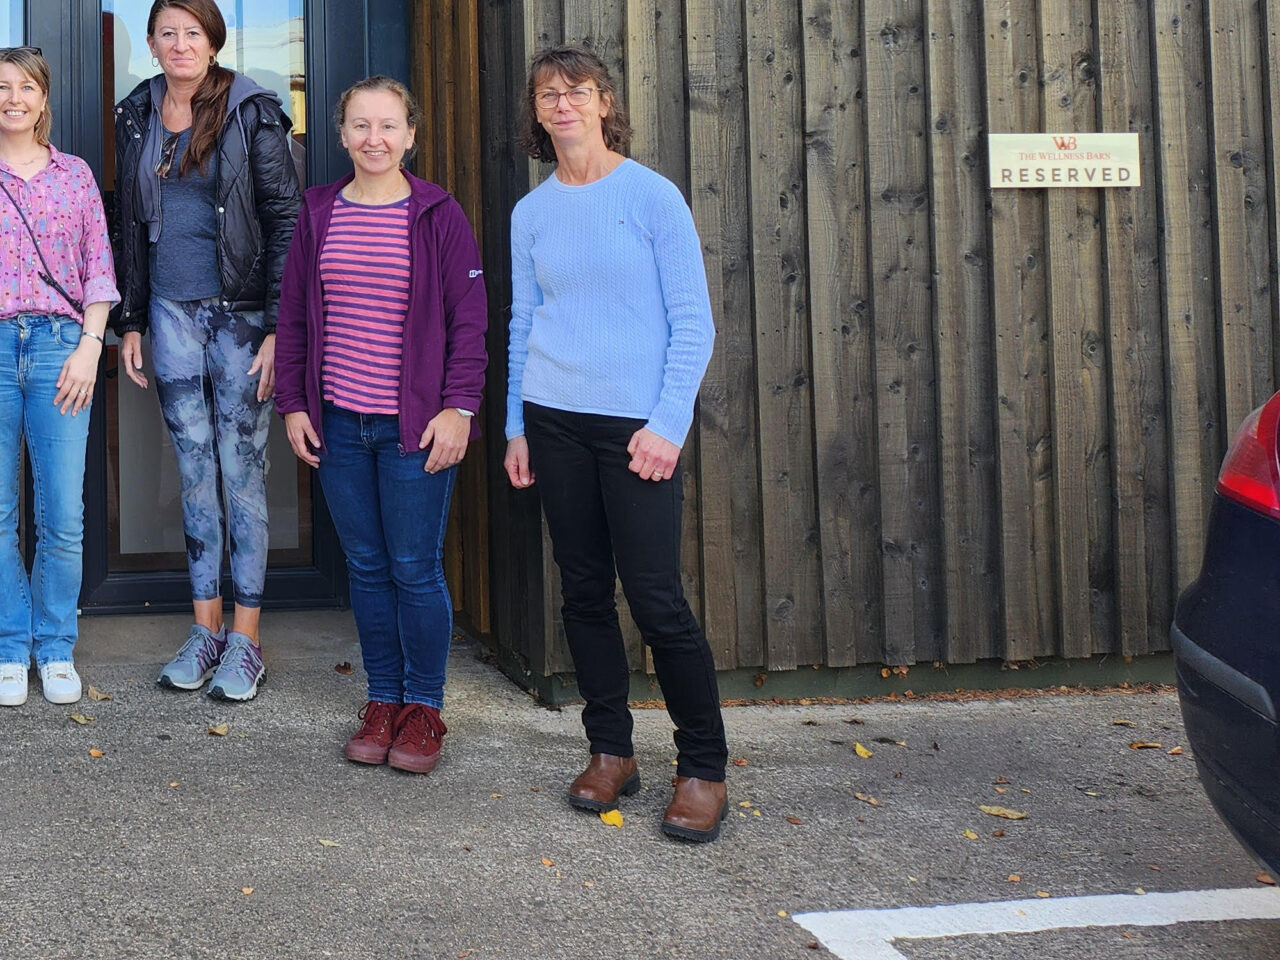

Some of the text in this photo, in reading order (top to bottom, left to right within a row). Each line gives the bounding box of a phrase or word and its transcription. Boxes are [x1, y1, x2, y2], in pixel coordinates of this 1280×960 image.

[1019, 152, 1111, 161] THE WELLNESS BARN
[1001, 168, 1131, 182] RESERVED
